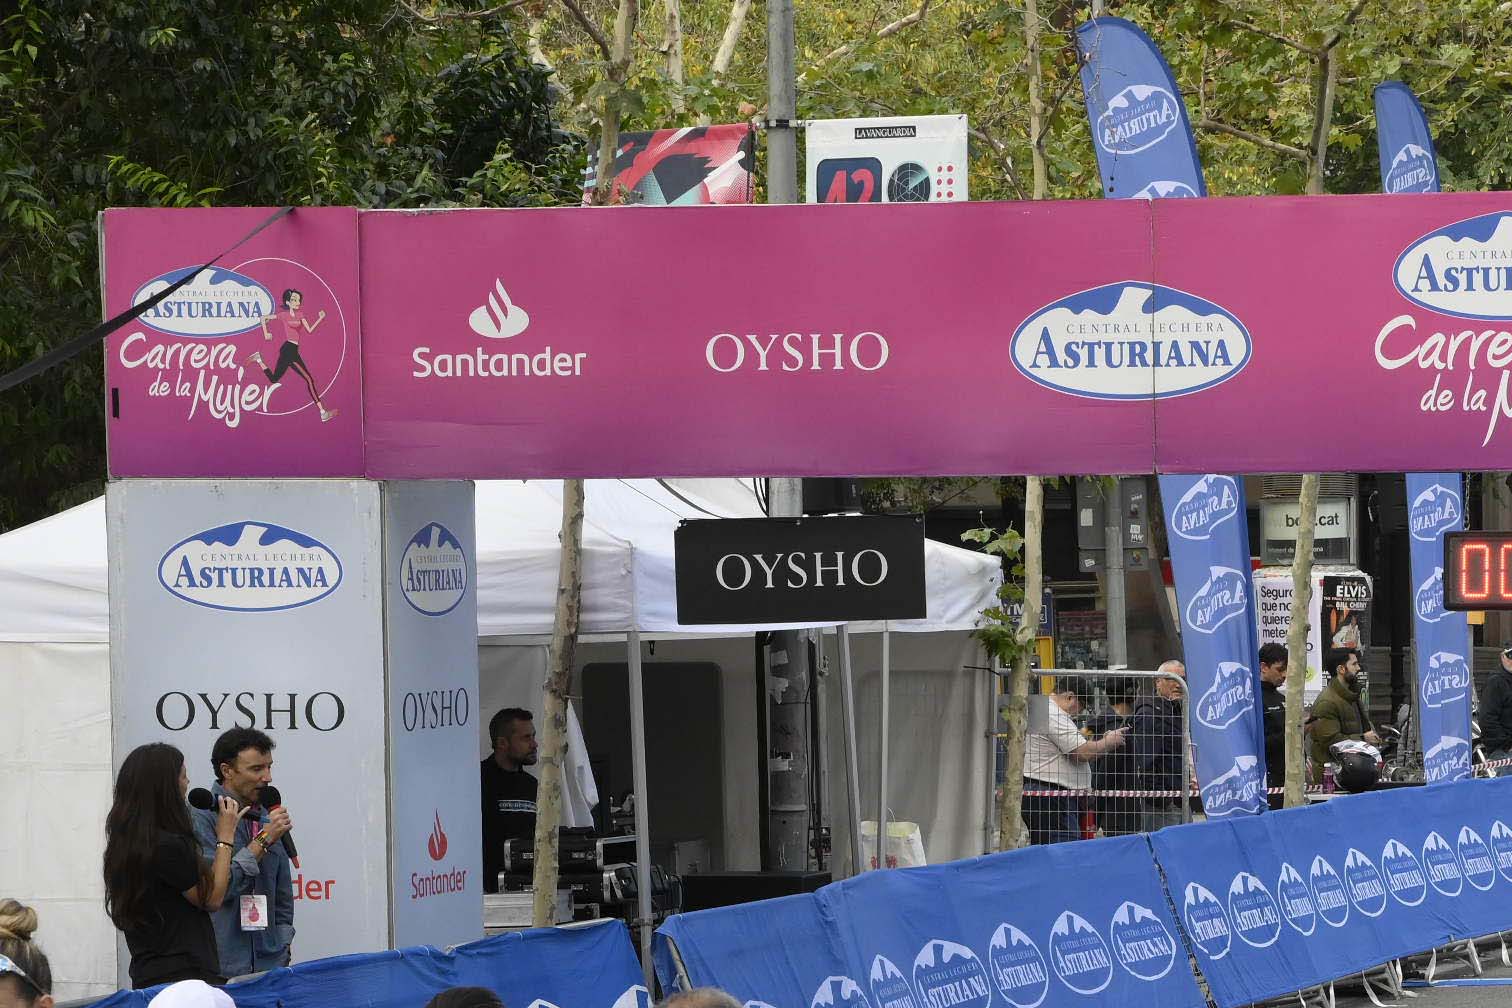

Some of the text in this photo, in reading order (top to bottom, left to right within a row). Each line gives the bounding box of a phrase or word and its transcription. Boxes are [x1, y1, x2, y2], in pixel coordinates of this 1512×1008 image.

[856, 127, 915, 138] LA VANGUARDIA
[142, 291, 264, 319] ASTURIANA
[1066, 320, 1225, 335] CENTRAL LECHERA
[119, 332, 237, 370] Carrera
[412, 346, 587, 379] Santander
[705, 331, 889, 373] OYSHO
[1029, 326, 1233, 370] ASTURIANA
[149, 366, 282, 428] de la Mujer
[1420, 371, 1452, 412] de
[1463, 371, 1487, 412] la
[173, 556, 329, 589] ASTURIANA
[201, 552, 323, 562] CENTRAL LECHERA
[716, 549, 889, 592] OYSHO
[406, 557, 464, 592] ASTURIANA
[1336, 585, 1367, 598] ELVIS
[1262, 602, 1278, 613] que
[155, 691, 345, 732] OYSHO
[402, 688, 469, 732] OYSHO
[411, 865, 467, 900] Santander
[994, 959, 1046, 991] ASTURIANA
[1055, 945, 1110, 977] ASTURIANA
